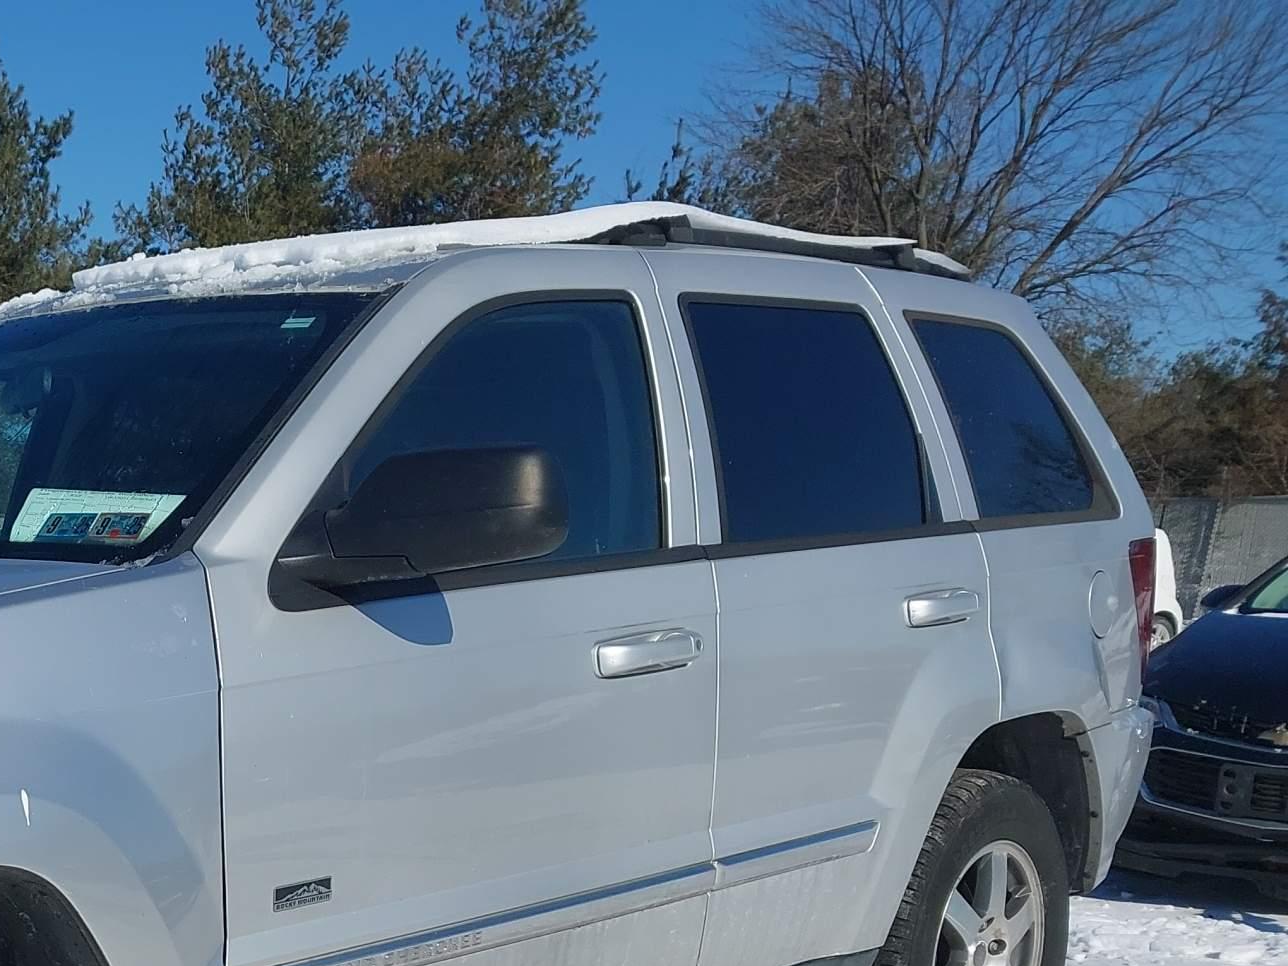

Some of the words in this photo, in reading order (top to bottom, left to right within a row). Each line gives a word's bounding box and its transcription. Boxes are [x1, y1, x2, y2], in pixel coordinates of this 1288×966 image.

[275, 901, 296, 910] ROCKY
[297, 894, 330, 904] MOUNTAIN
[384, 931, 483, 966] CHEROKEE
